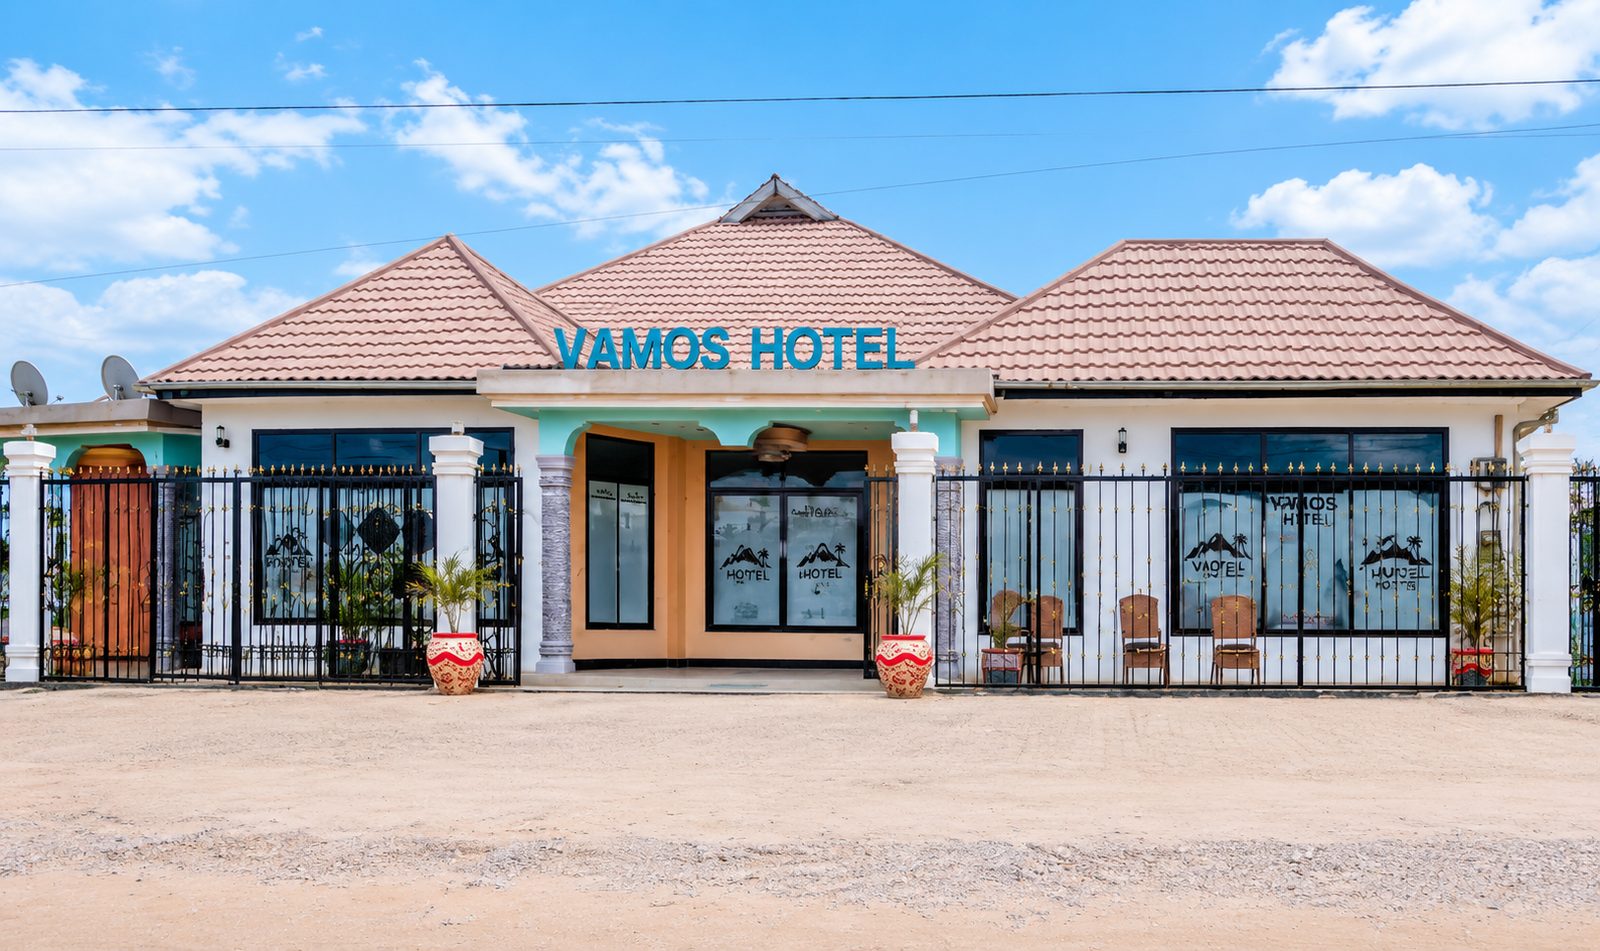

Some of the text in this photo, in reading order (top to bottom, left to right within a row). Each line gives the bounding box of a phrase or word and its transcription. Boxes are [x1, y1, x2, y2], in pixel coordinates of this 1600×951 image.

[554, 327, 916, 370] VAMOS HOTEL
[727, 569, 770, 581] HOTEL
